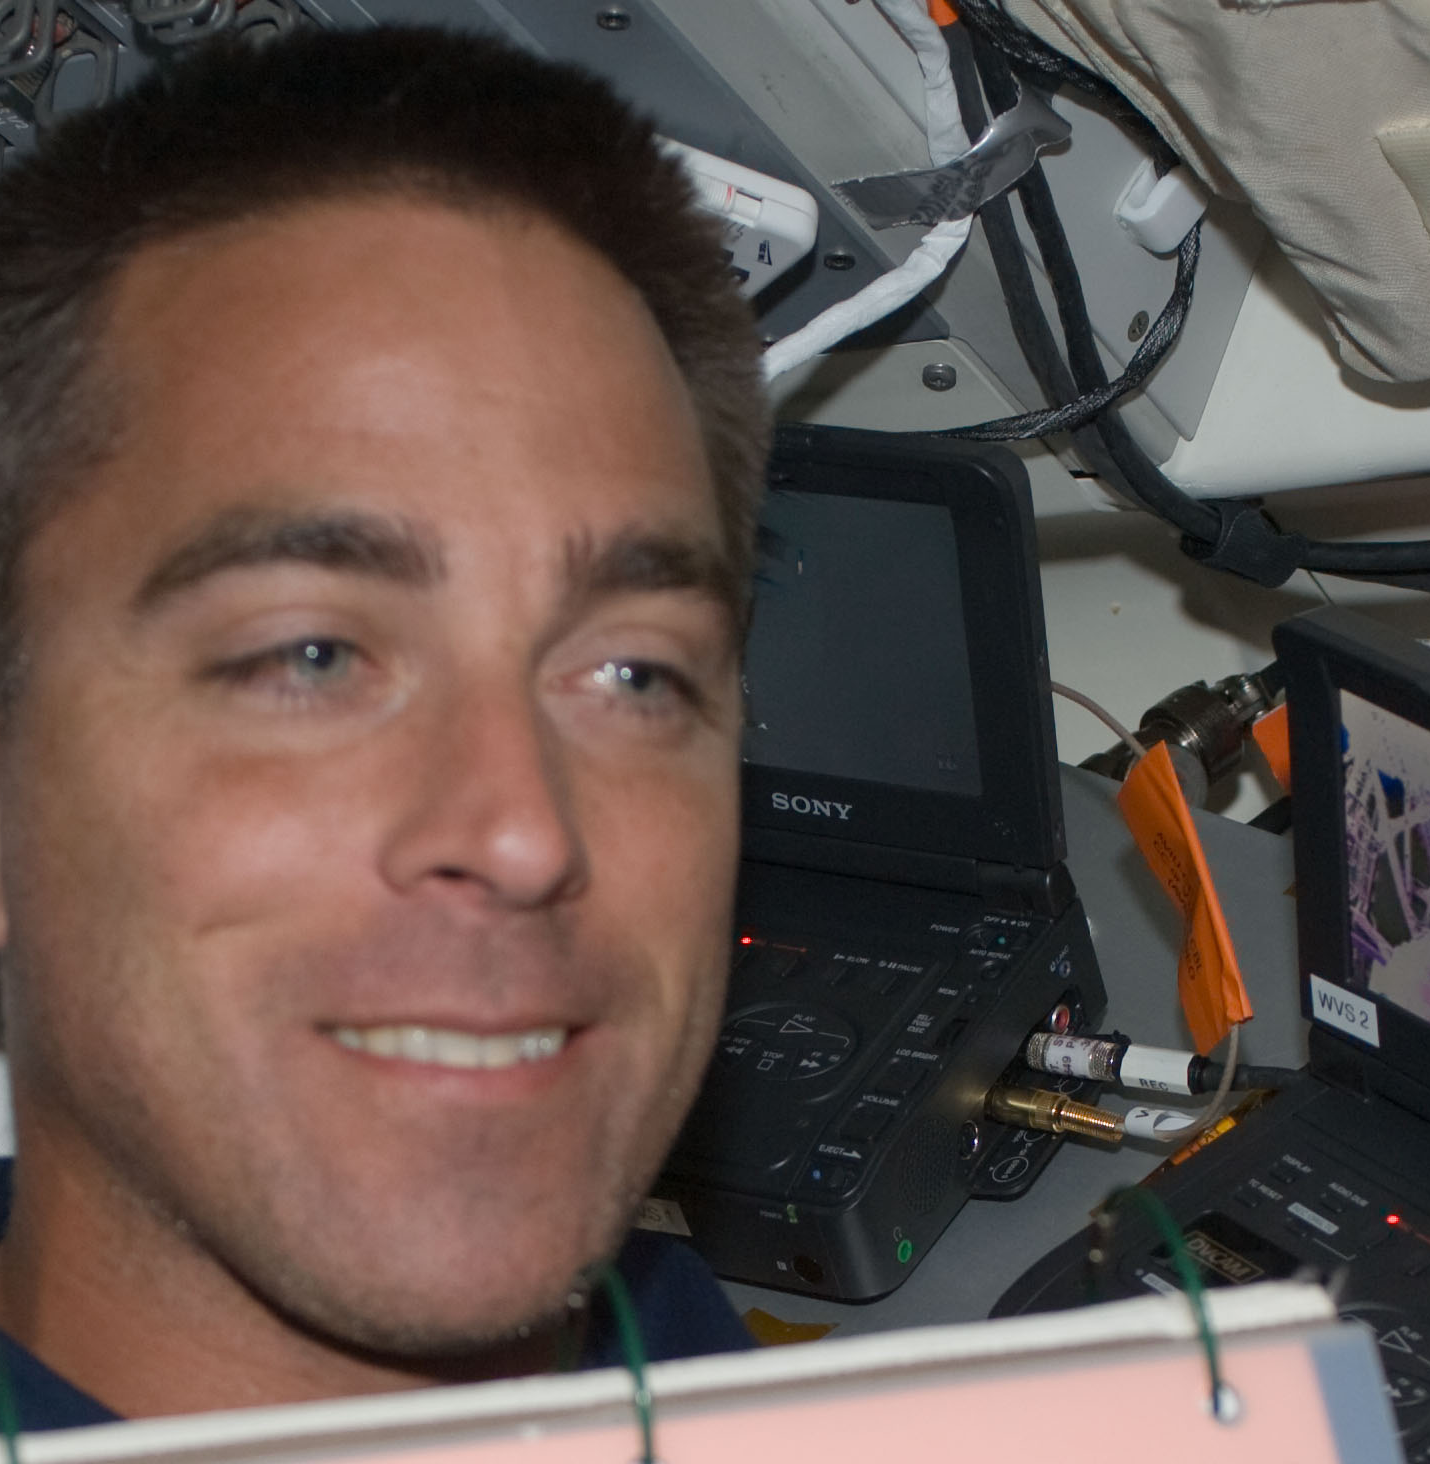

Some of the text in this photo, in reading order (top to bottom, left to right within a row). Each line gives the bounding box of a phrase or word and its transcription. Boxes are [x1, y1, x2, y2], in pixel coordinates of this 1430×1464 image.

[771, 792, 853, 820] SONY
[793, 1013, 817, 1023] PLAY
[1317, 989, 1370, 1030] WVS 2
[818, 1144, 844, 1156] EJECT
[1186, 1237, 1254, 1278] DVCAM
